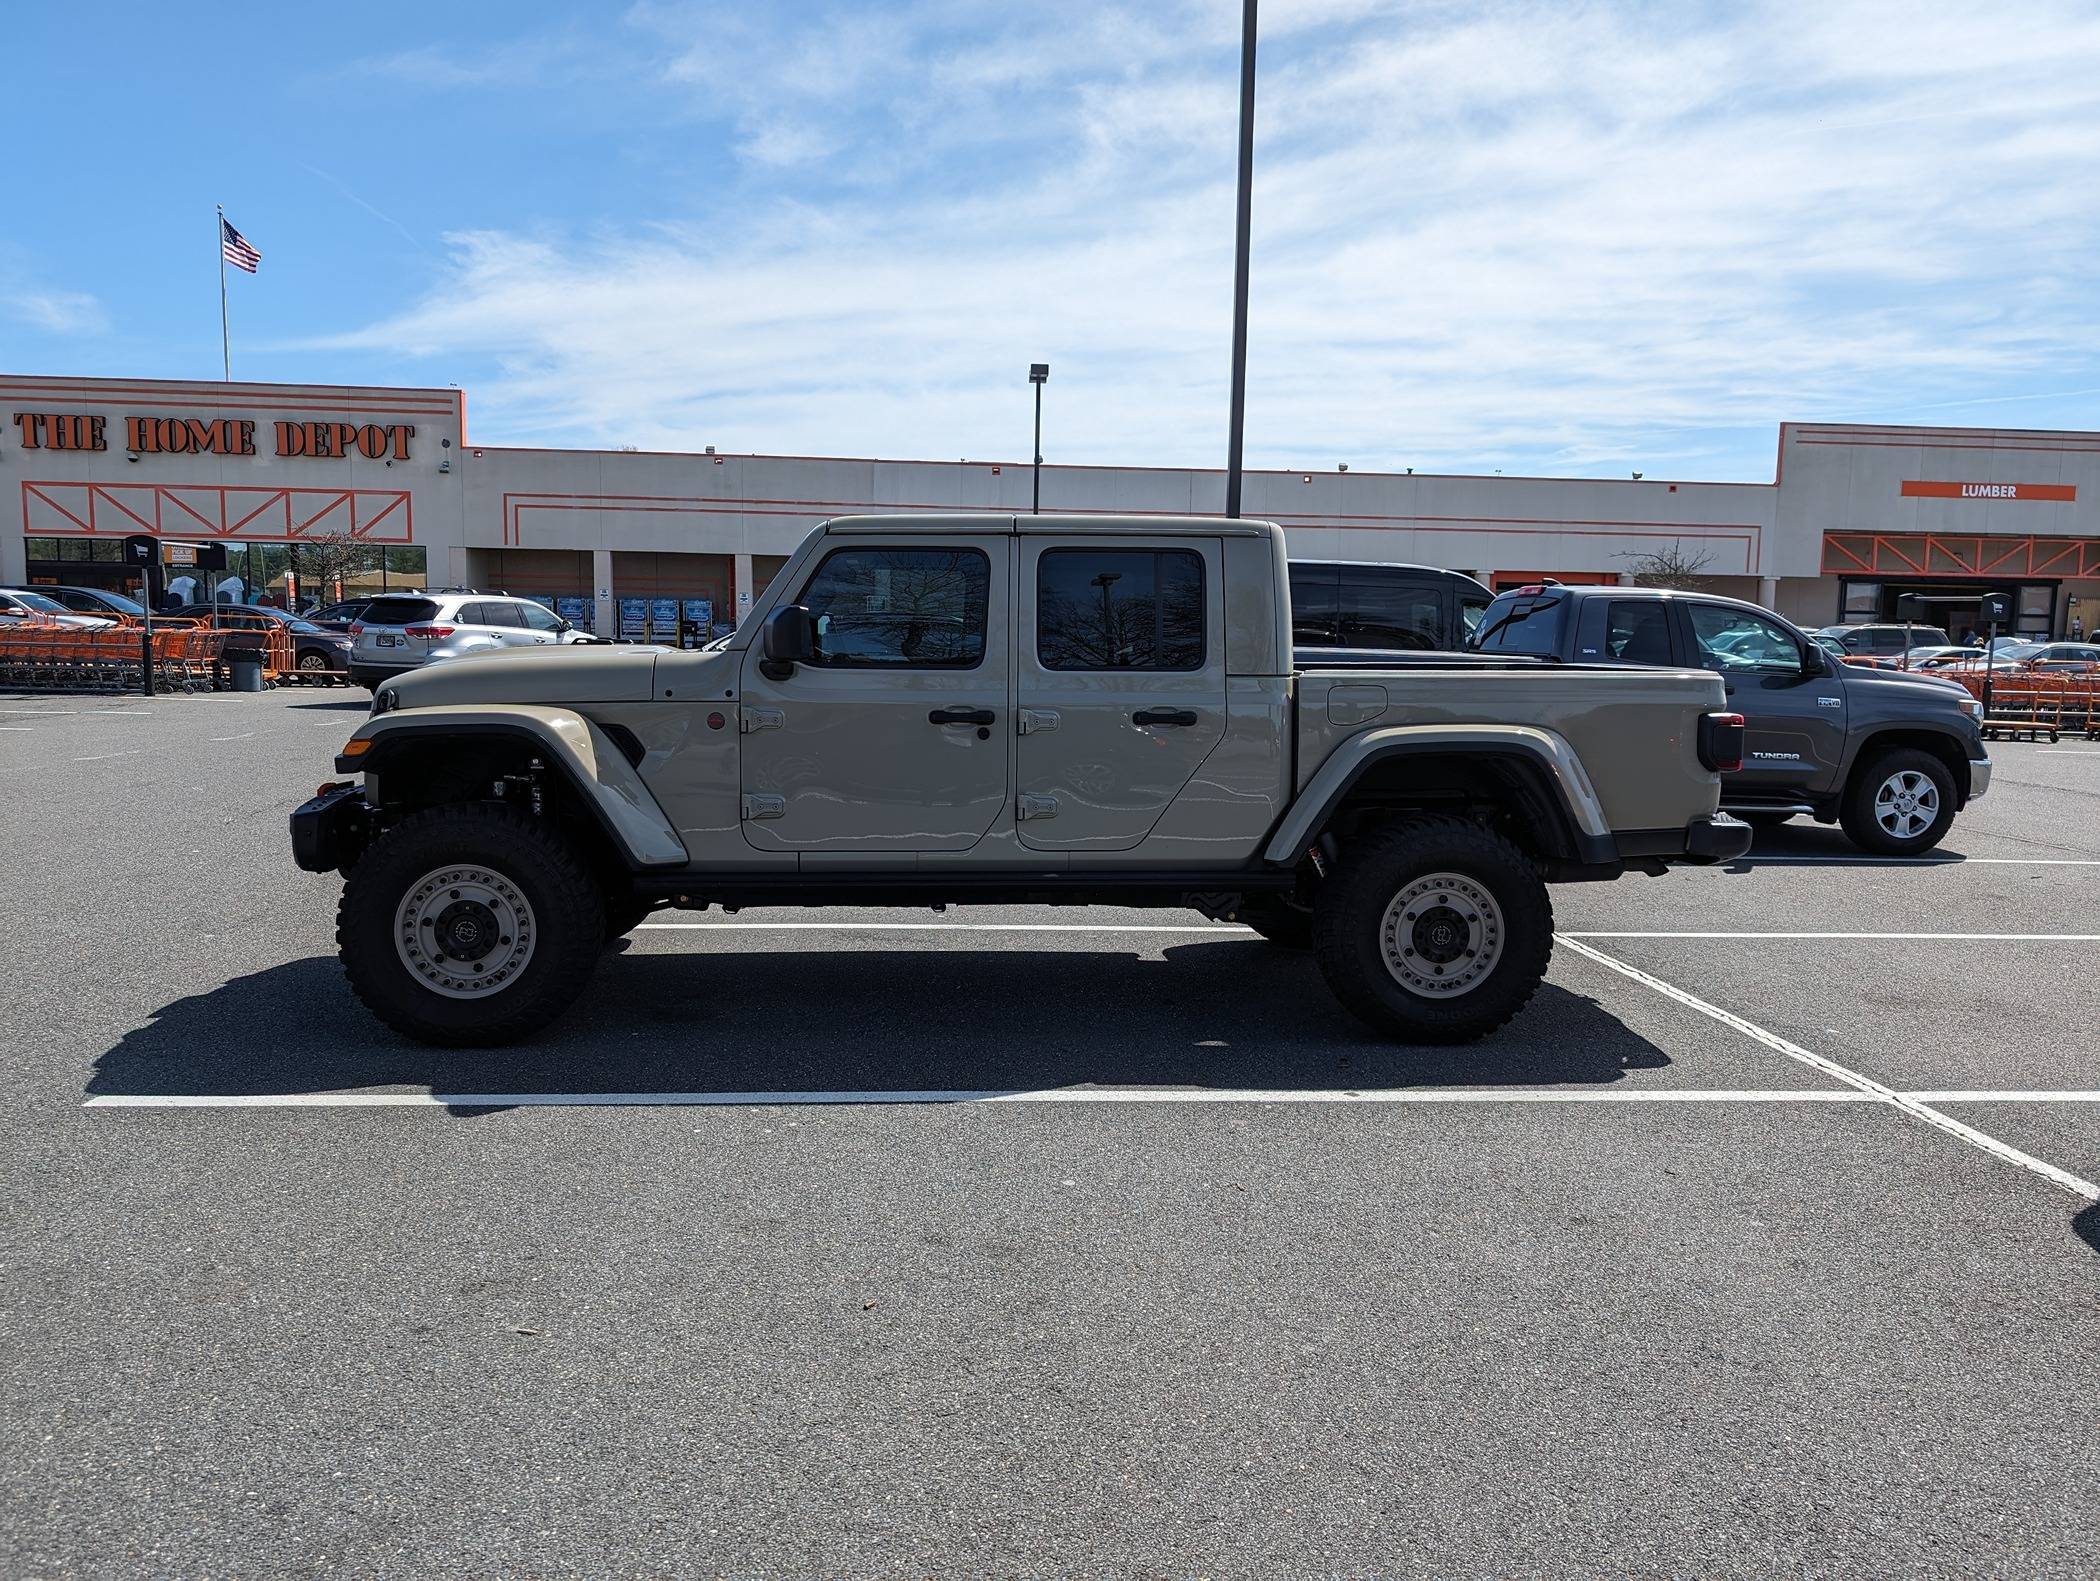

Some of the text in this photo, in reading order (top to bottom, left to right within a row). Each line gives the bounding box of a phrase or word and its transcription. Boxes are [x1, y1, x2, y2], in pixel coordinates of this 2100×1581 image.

[14, 413, 415, 460] THE HOME DEPOT
[1961, 484, 2017, 498] LUMBER
[1752, 751, 1800, 760] TUNDRA
